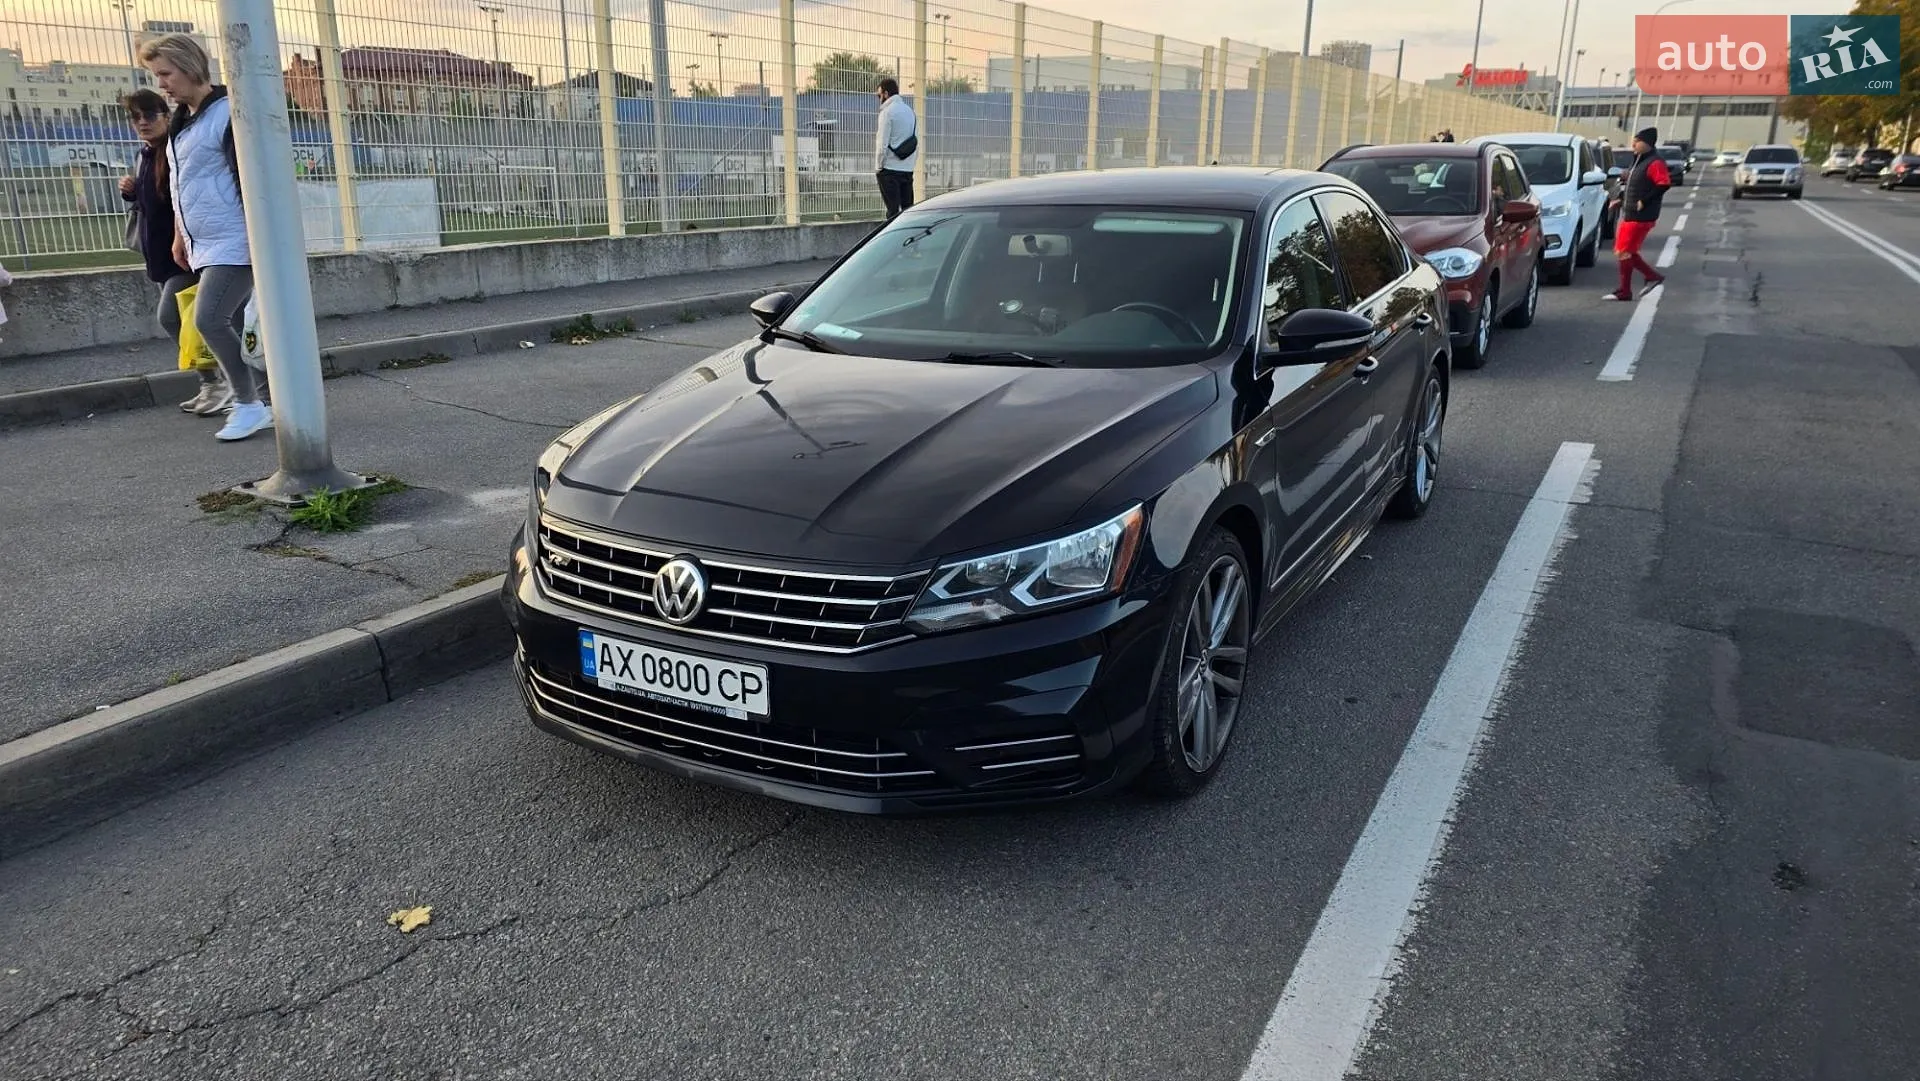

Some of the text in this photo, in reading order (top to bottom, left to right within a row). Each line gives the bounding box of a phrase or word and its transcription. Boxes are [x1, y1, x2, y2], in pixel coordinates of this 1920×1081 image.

[68, 147, 97, 160] DCH
[584, 659, 595, 670] UA
[599, 643, 763, 704] AX 0800 CP
